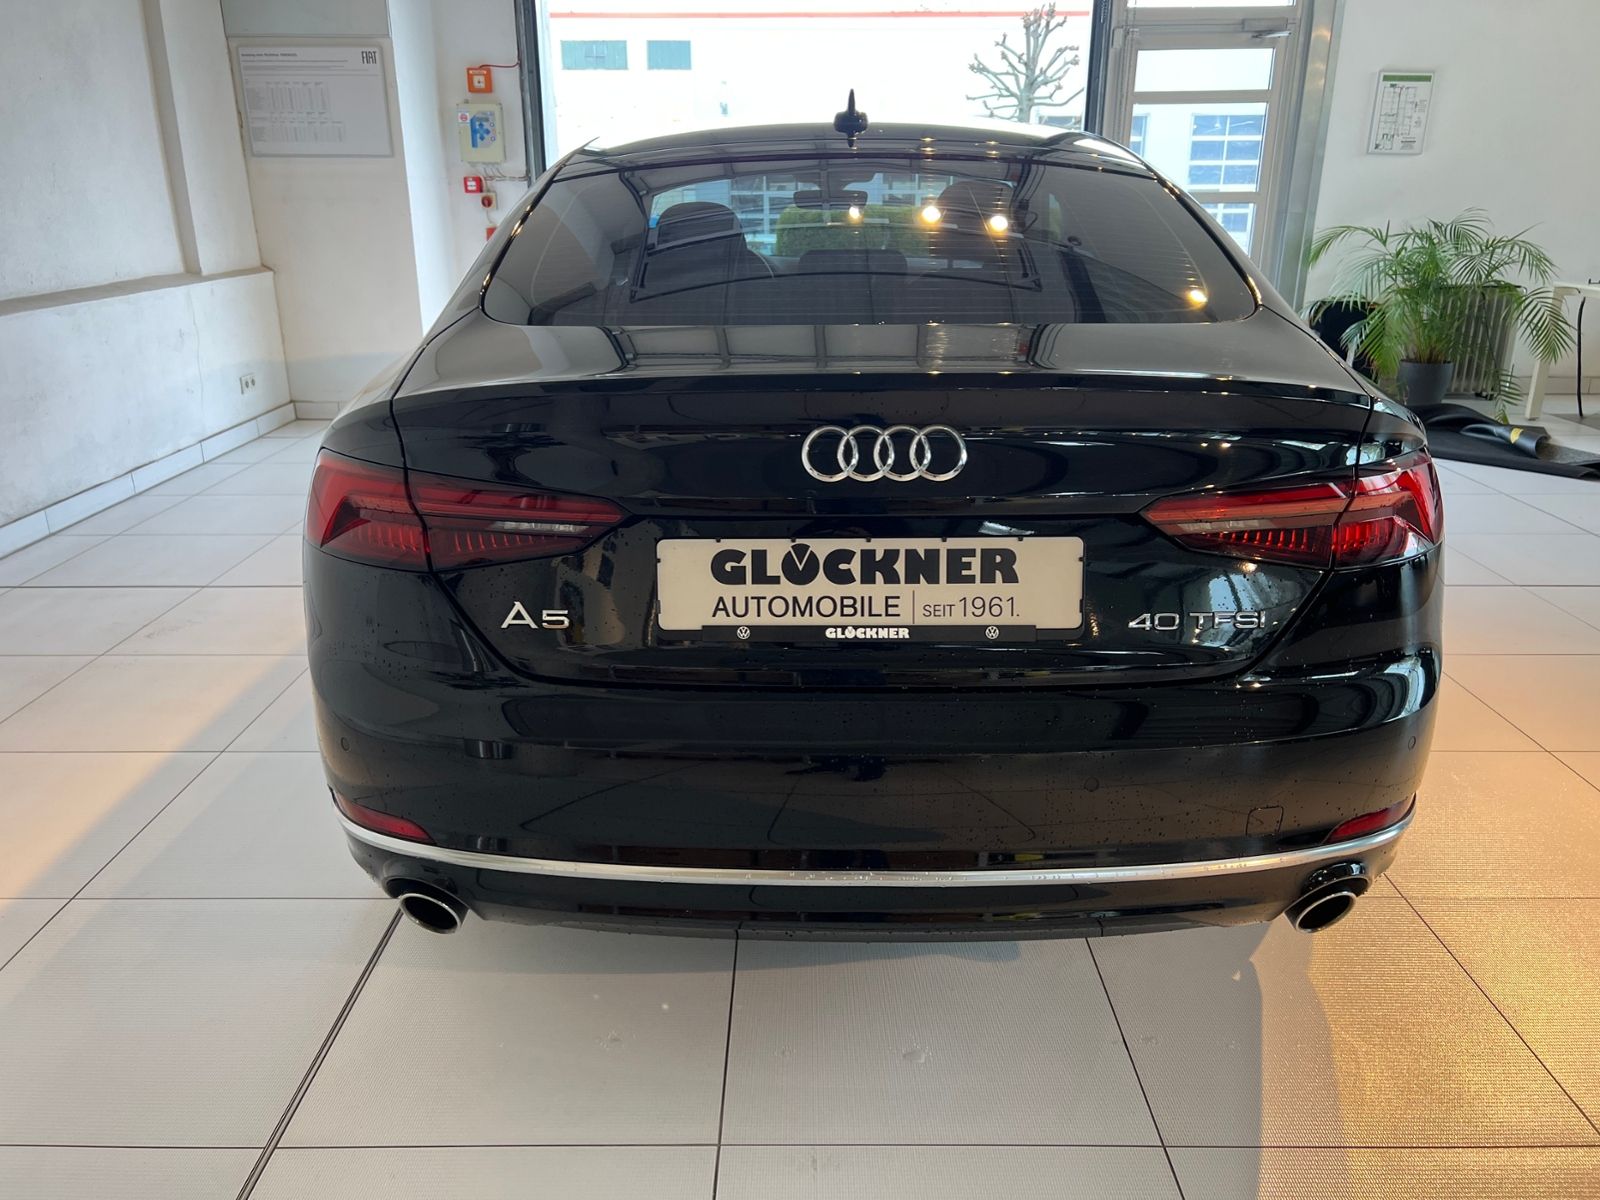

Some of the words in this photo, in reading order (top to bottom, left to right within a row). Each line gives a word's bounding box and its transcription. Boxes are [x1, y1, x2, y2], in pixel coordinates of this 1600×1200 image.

[361, 51, 377, 64] FIAT
[501, 601, 569, 629] A5
[712, 596, 900, 617] AUTOMOBILE
[922, 604, 955, 617] SEIT
[959, 596, 1019, 617] 1961.
[1128, 612, 1180, 631] 40
[1189, 610, 1266, 630] TFSI
